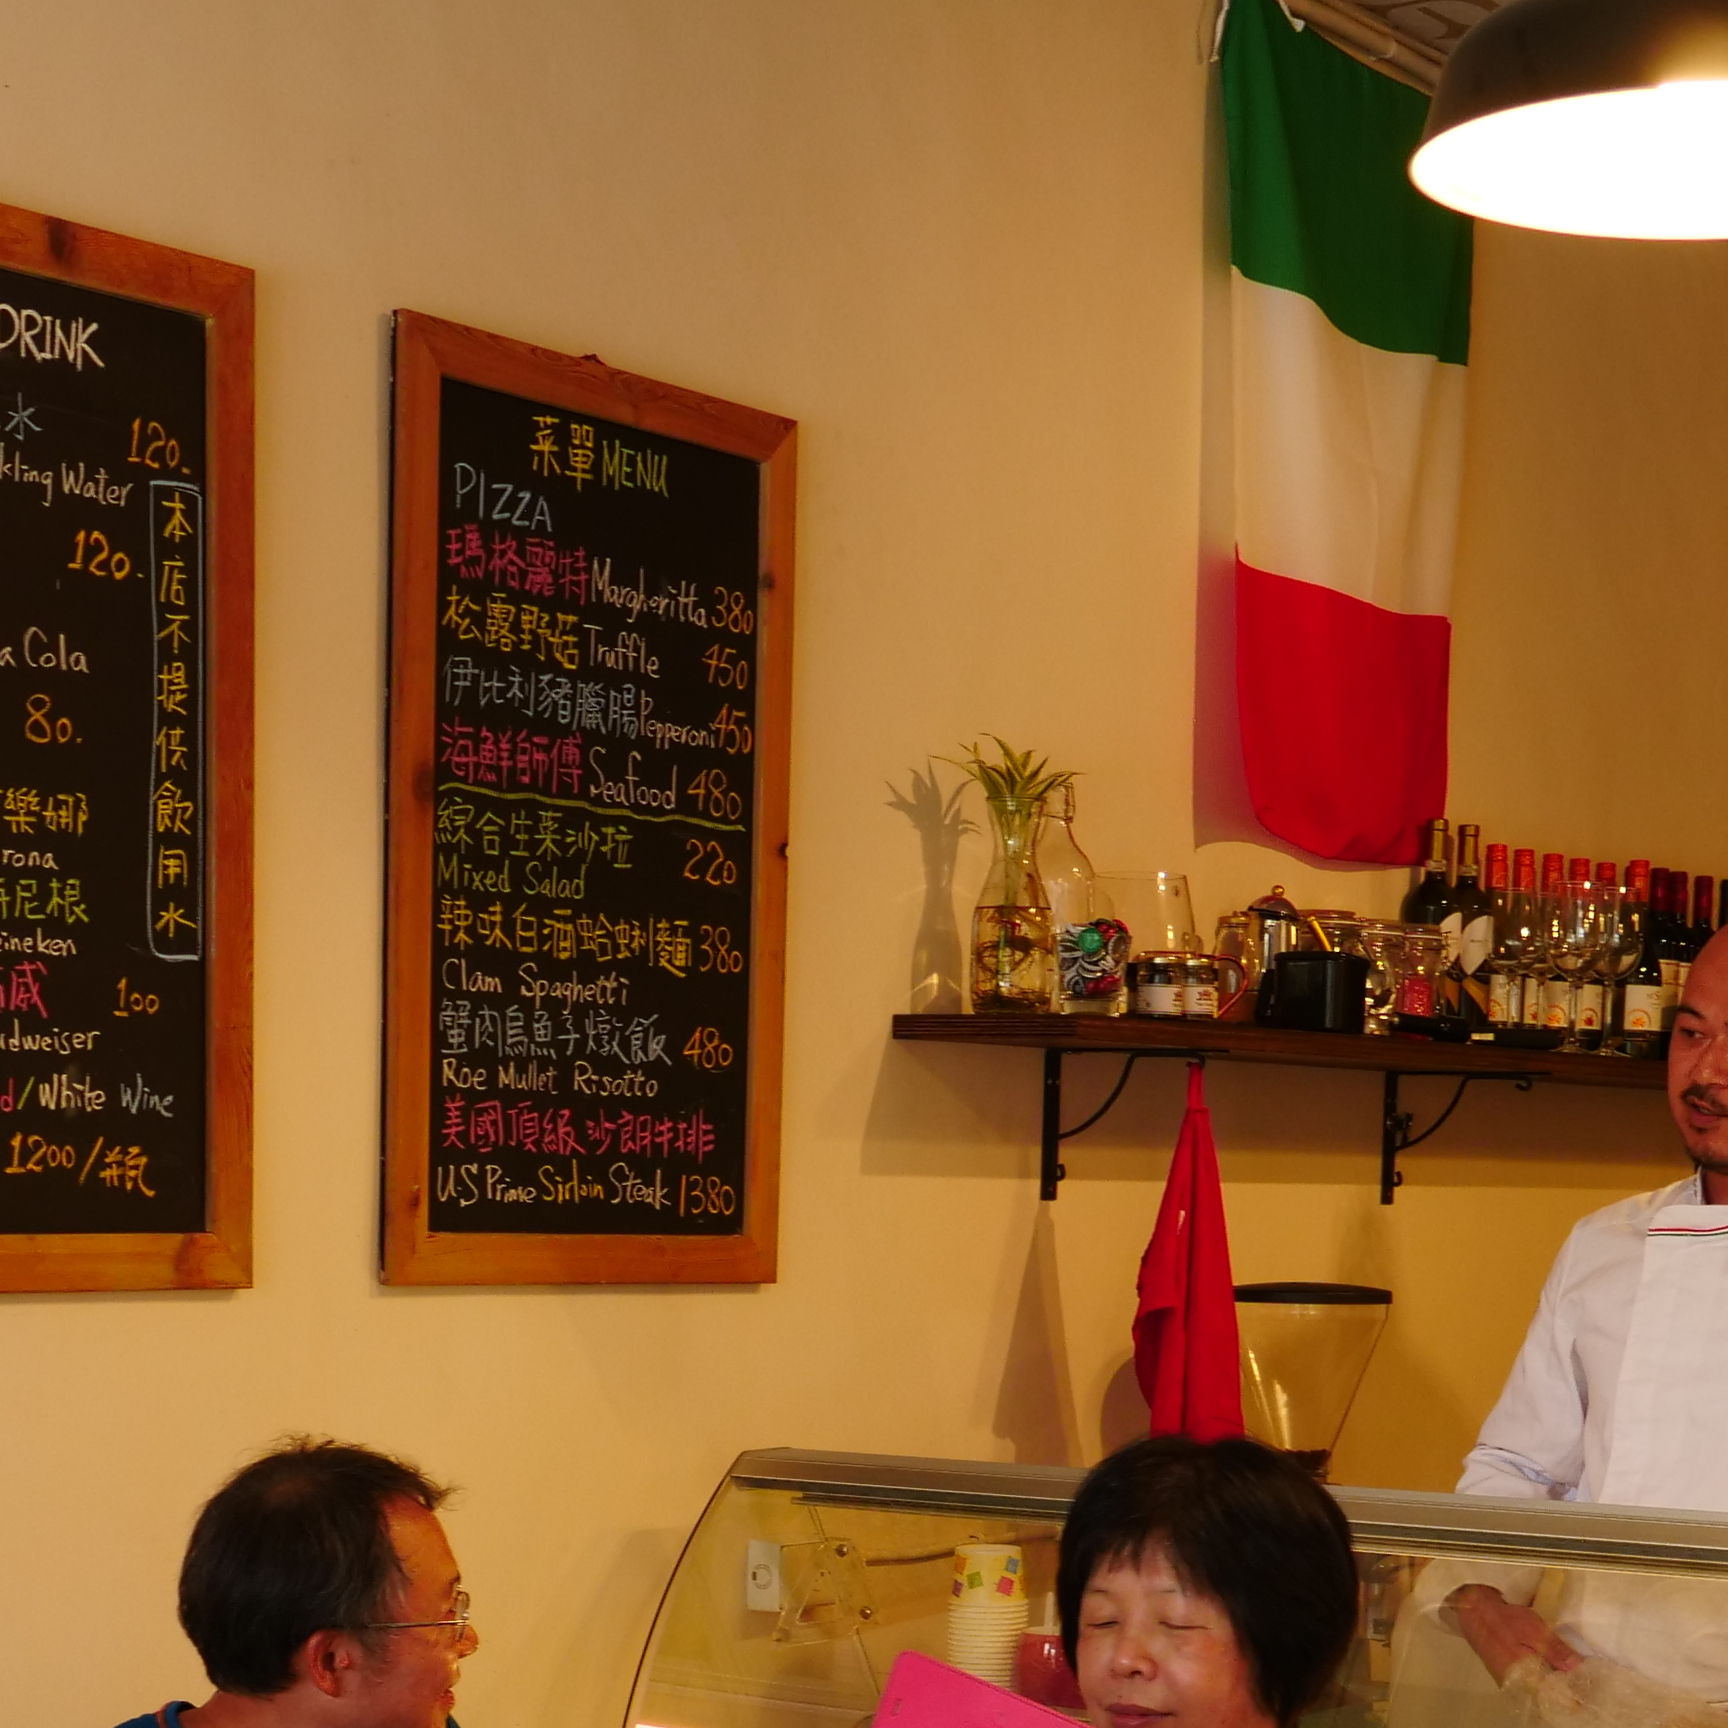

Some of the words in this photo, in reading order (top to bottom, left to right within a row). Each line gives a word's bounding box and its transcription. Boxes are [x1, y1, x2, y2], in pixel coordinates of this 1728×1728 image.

[529, 415, 594, 493] 菜單
[602, 439, 670, 499] MENU
[62, 462, 134, 507] Water
[453, 462, 554, 534] PIZZA
[444, 523, 590, 607] 瑪格麗特
[710, 586, 755, 636] 380
[23, 626, 90, 674] Cola
[441, 584, 580, 670] 松露野菇
[582, 623, 661, 680] Truffle
[701, 643, 749, 690] 450
[153, 490, 197, 939] 本店不提供飲用水
[640, 689, 715, 750] Pepperoni
[713, 703, 753, 756] 450
[589, 746, 678, 811] Seafood
[687, 768, 743, 821] 480
[437, 852, 512, 894] Mixed
[522, 861, 587, 900] Salad
[683, 838, 738, 887] 220
[698, 924, 744, 974] 380
[112, 977, 160, 1018] 100
[441, 957, 503, 995] Clam
[518, 962, 631, 1016] Spaghetti
[682, 1026, 734, 1070] 480
[120, 1073, 174, 1119] Wine
[441, 1058, 488, 1090] Roe
[498, 1061, 559, 1095] Mullet
[573, 1060, 660, 1098] Risotto
[485, 1164, 537, 1204] Prime
[608, 1162, 672, 1210] Steak
[678, 1174, 737, 1218] 1380
